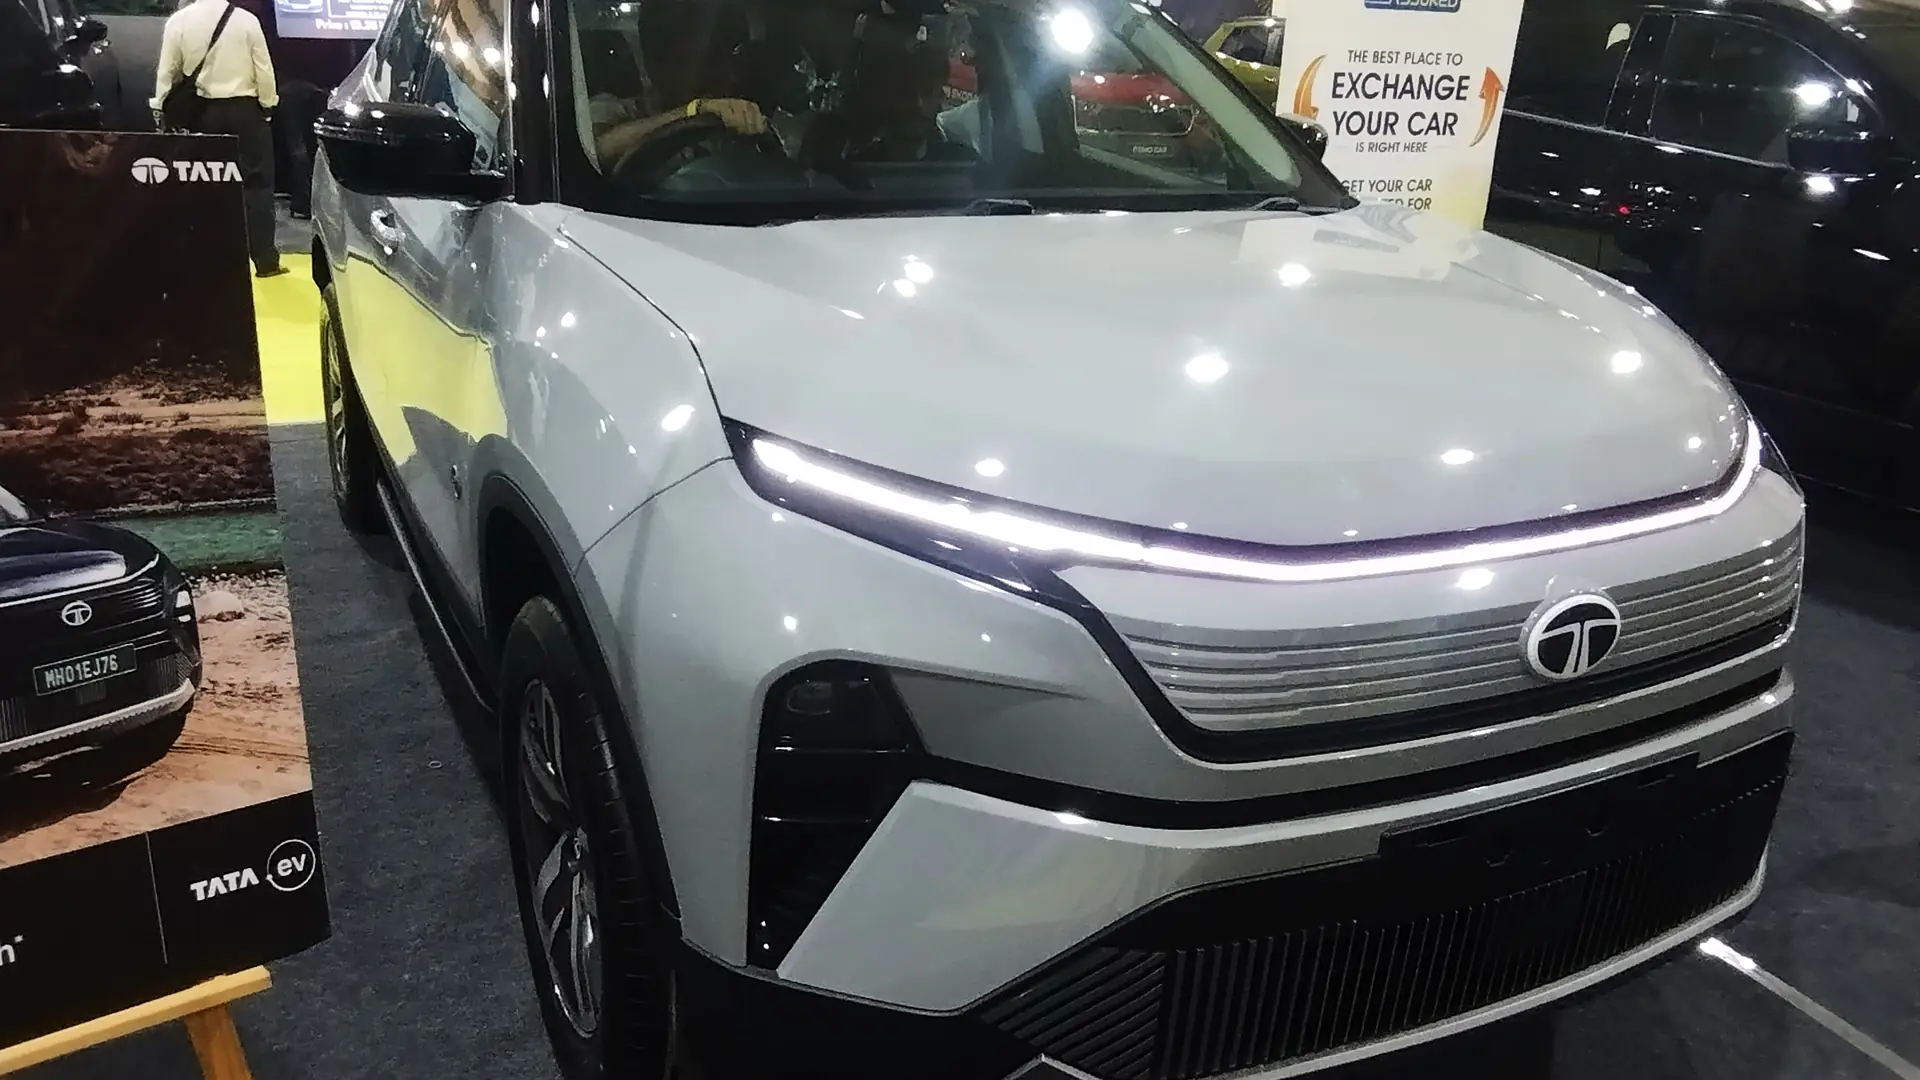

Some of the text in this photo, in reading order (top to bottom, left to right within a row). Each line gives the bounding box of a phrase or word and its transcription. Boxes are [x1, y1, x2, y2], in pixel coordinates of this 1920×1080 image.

[1348, 50, 1463, 66] THE BEST PLACE TO
[1331, 72, 1471, 101] EXCHANGE
[1333, 111, 1459, 136] YOUR CAR
[1355, 141, 1428, 153] IS RIGHT HERE
[173, 160, 242, 182] TATA
[1341, 178, 1433, 193] GET YOUR CAR
[1407, 197, 1432, 211] FOR
[44, 654, 119, 689] MH01EJ76
[190, 867, 260, 901] TATA
